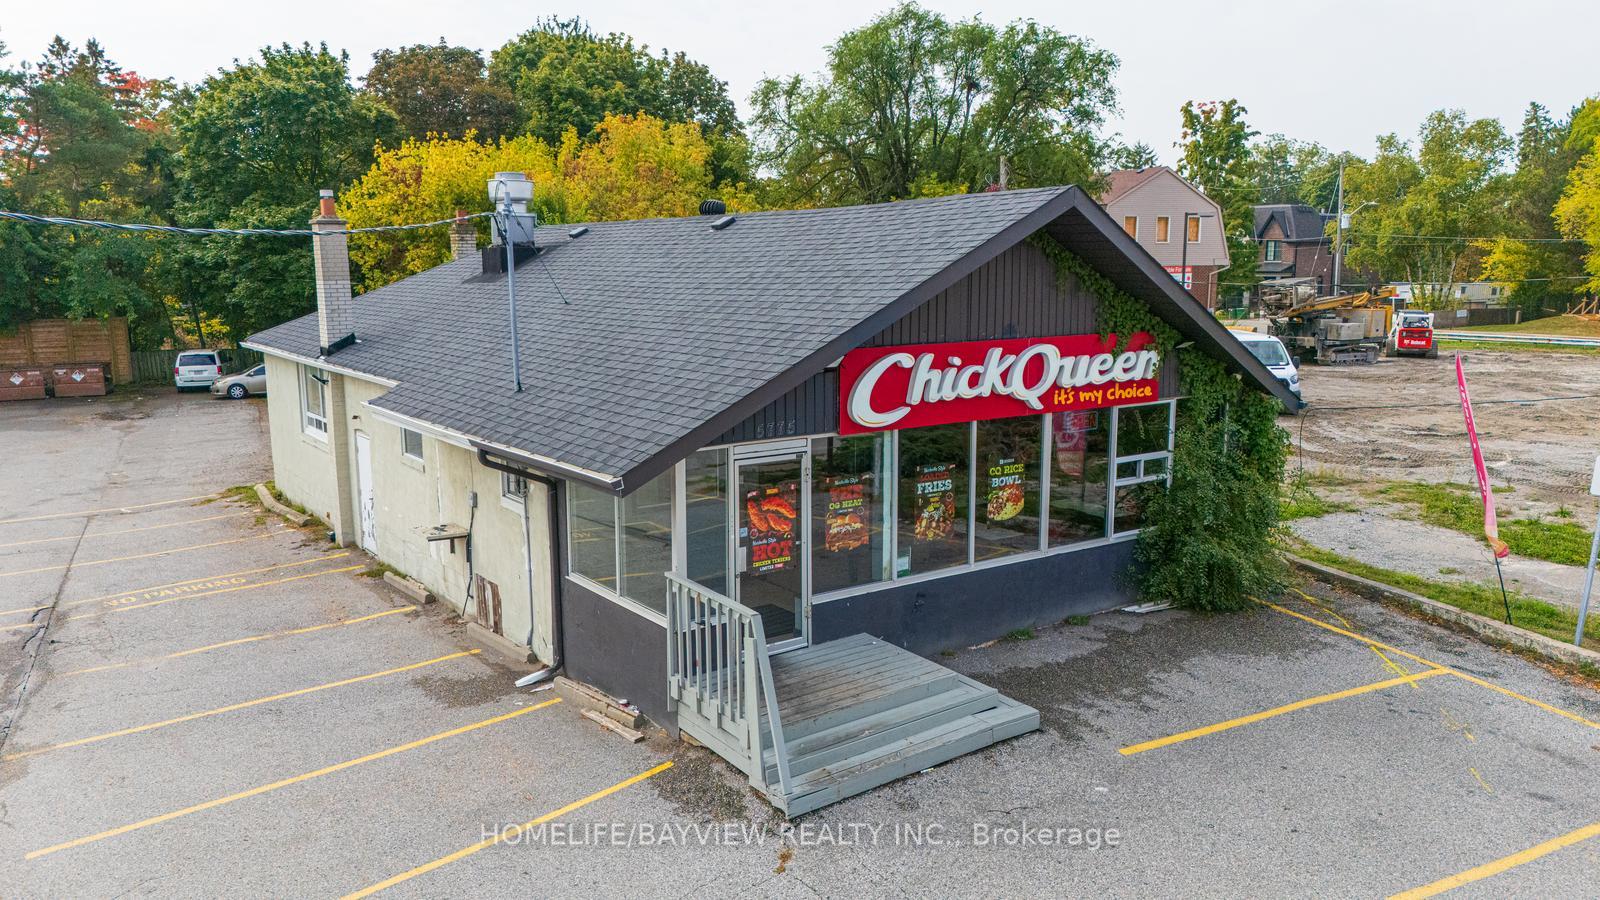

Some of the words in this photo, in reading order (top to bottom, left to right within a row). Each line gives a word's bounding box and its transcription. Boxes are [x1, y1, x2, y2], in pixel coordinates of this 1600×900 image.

[847, 343, 1159, 428] ChickQueen
[1053, 387, 1075, 405] it's
[1079, 389, 1103, 405] my
[1106, 383, 1152, 400] choice
[1004, 463, 1024, 474] RICE
[917, 479, 952, 494] FRIES
[992, 475, 1021, 487] BOWL
[842, 498, 863, 508] HEAT
[752, 541, 792, 561] HOT
[104, 596, 137, 607] NO
[143, 577, 247, 600] PARKING
